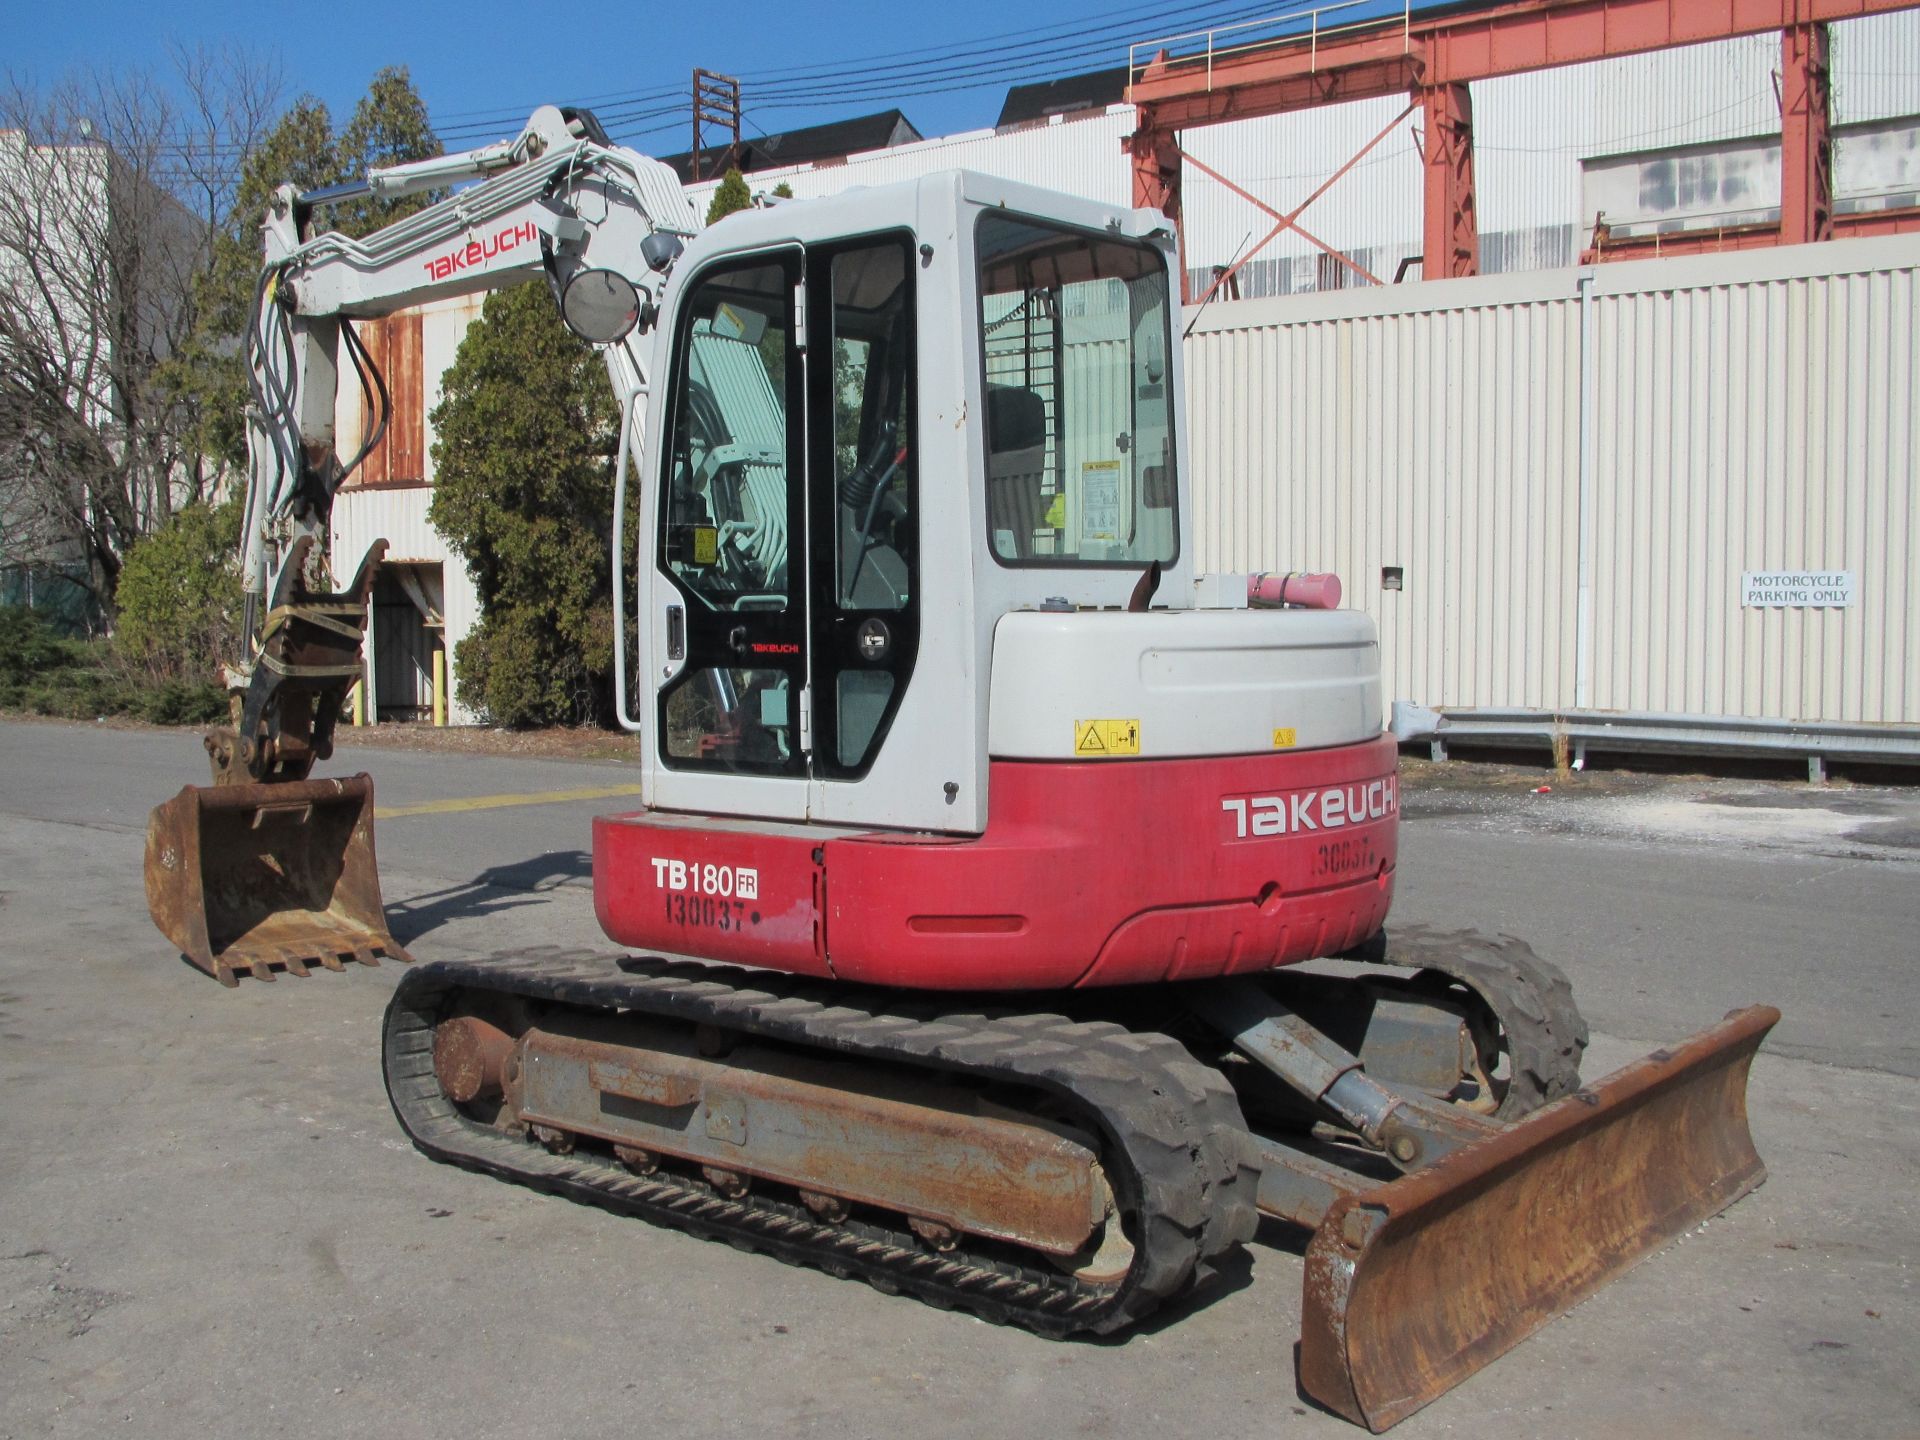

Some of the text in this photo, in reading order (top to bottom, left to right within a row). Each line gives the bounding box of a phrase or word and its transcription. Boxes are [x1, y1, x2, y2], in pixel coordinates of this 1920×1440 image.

[1752, 575, 1844, 587] MOTORCYCLE
[1748, 590, 1849, 602] PARKING ONLY
[651, 857, 756, 897] TB180 FR
